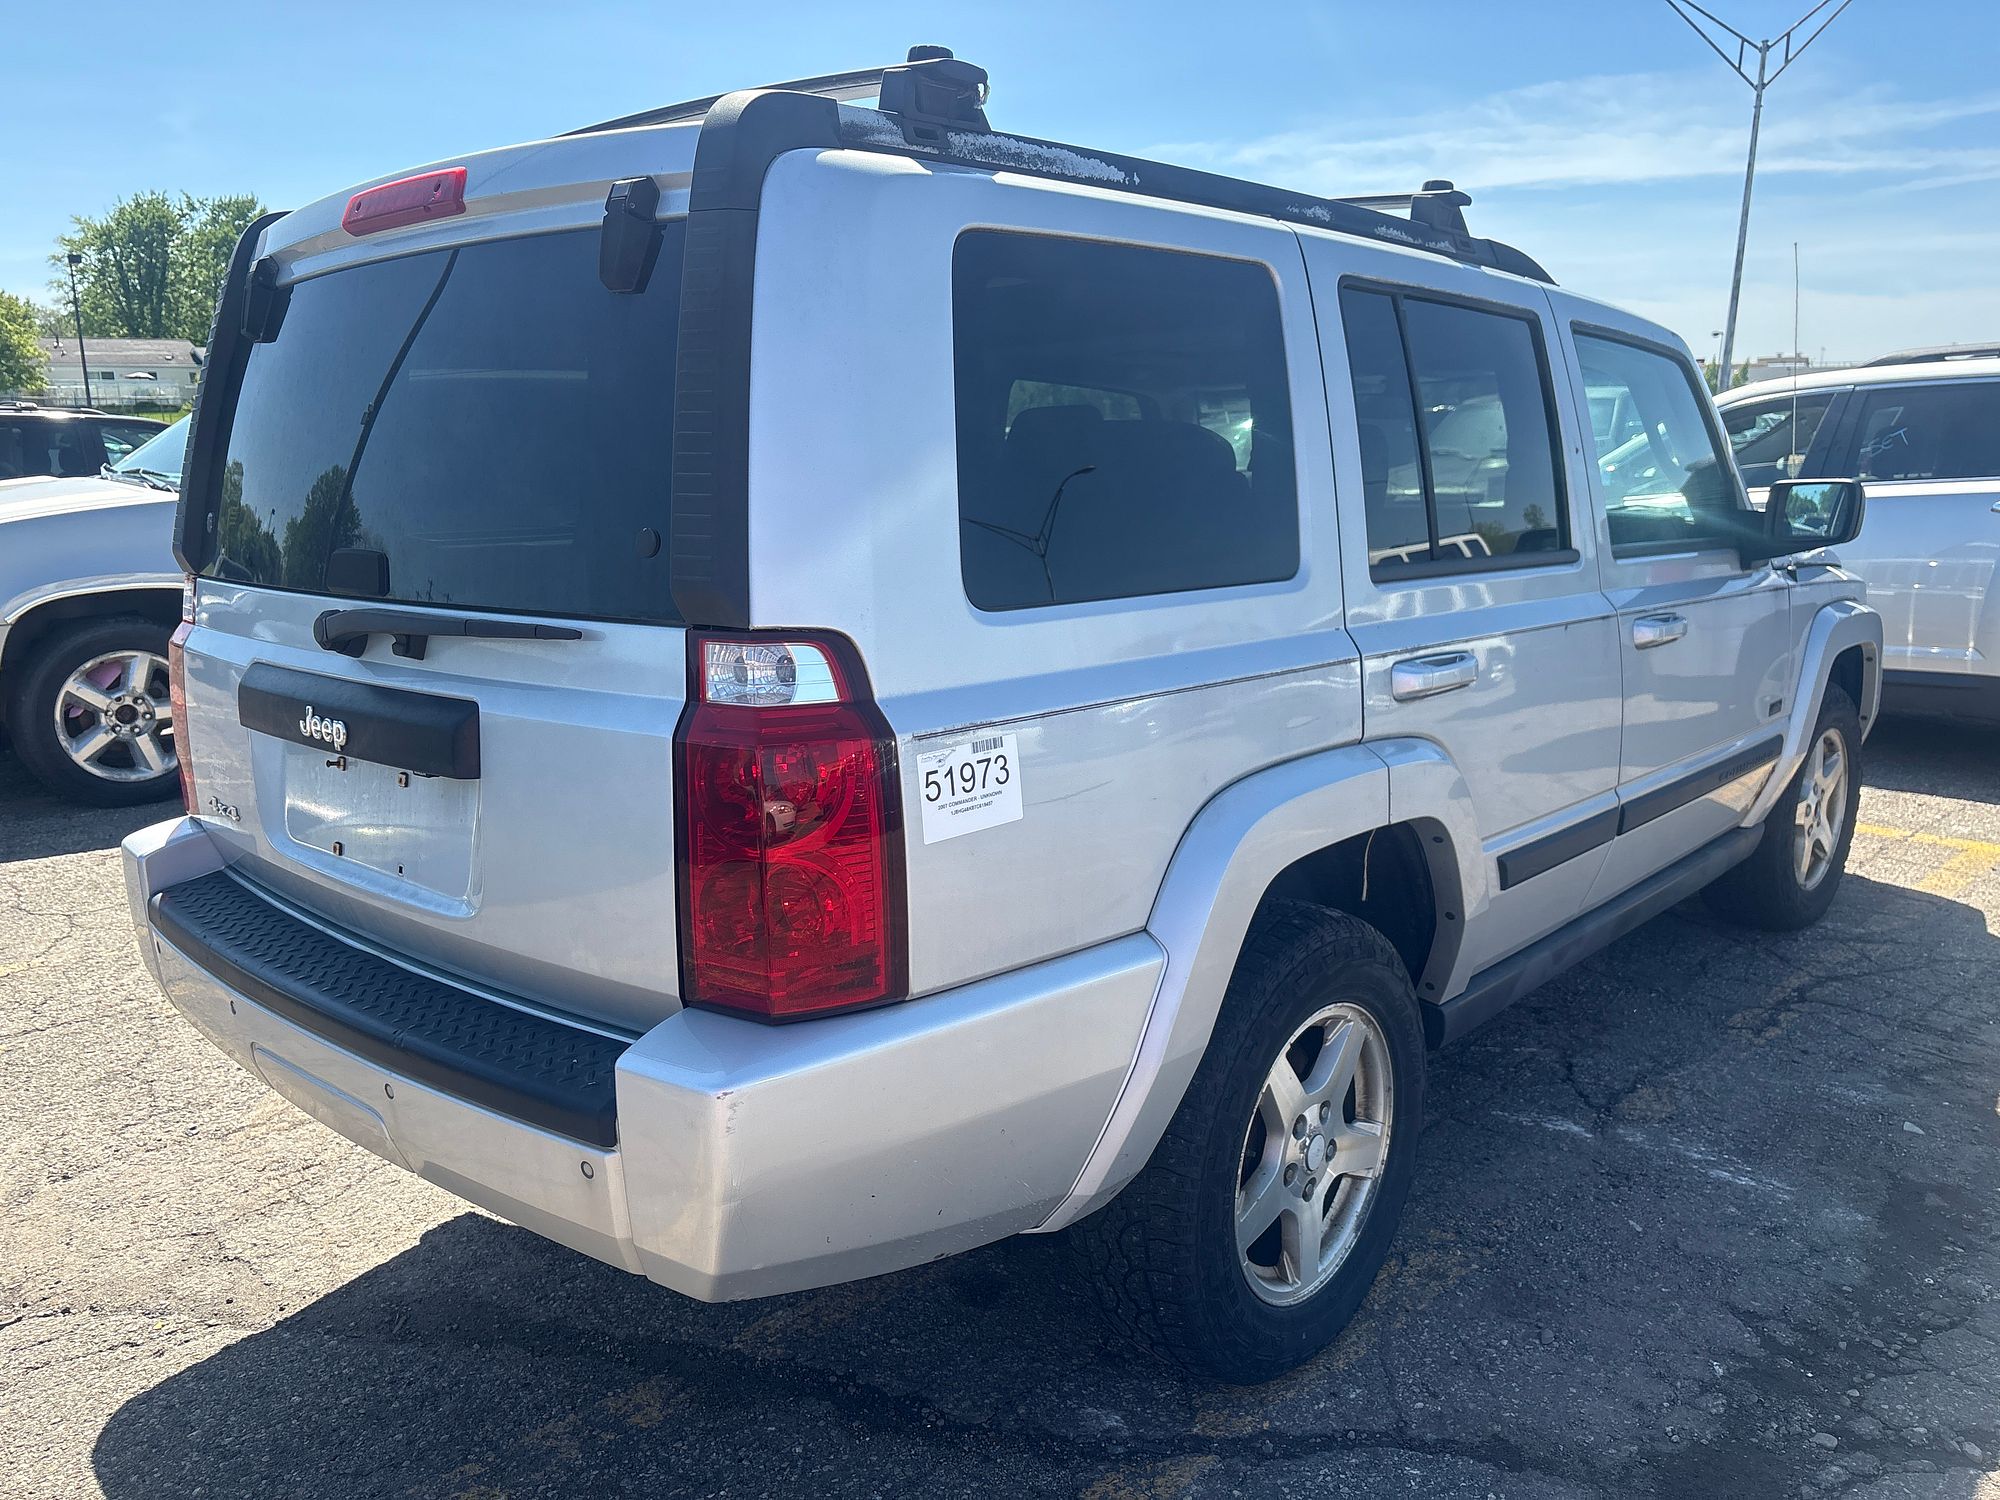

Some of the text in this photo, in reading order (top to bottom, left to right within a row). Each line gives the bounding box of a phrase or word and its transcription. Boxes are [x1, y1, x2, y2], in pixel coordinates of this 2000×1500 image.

[299, 705, 347, 751] Jeep
[925, 754, 1010, 802] 51973
[208, 796, 241, 822] 4x4
[948, 796, 978, 808] COMMANDER
[980, 790, 1003, 800] UNKNOWN
